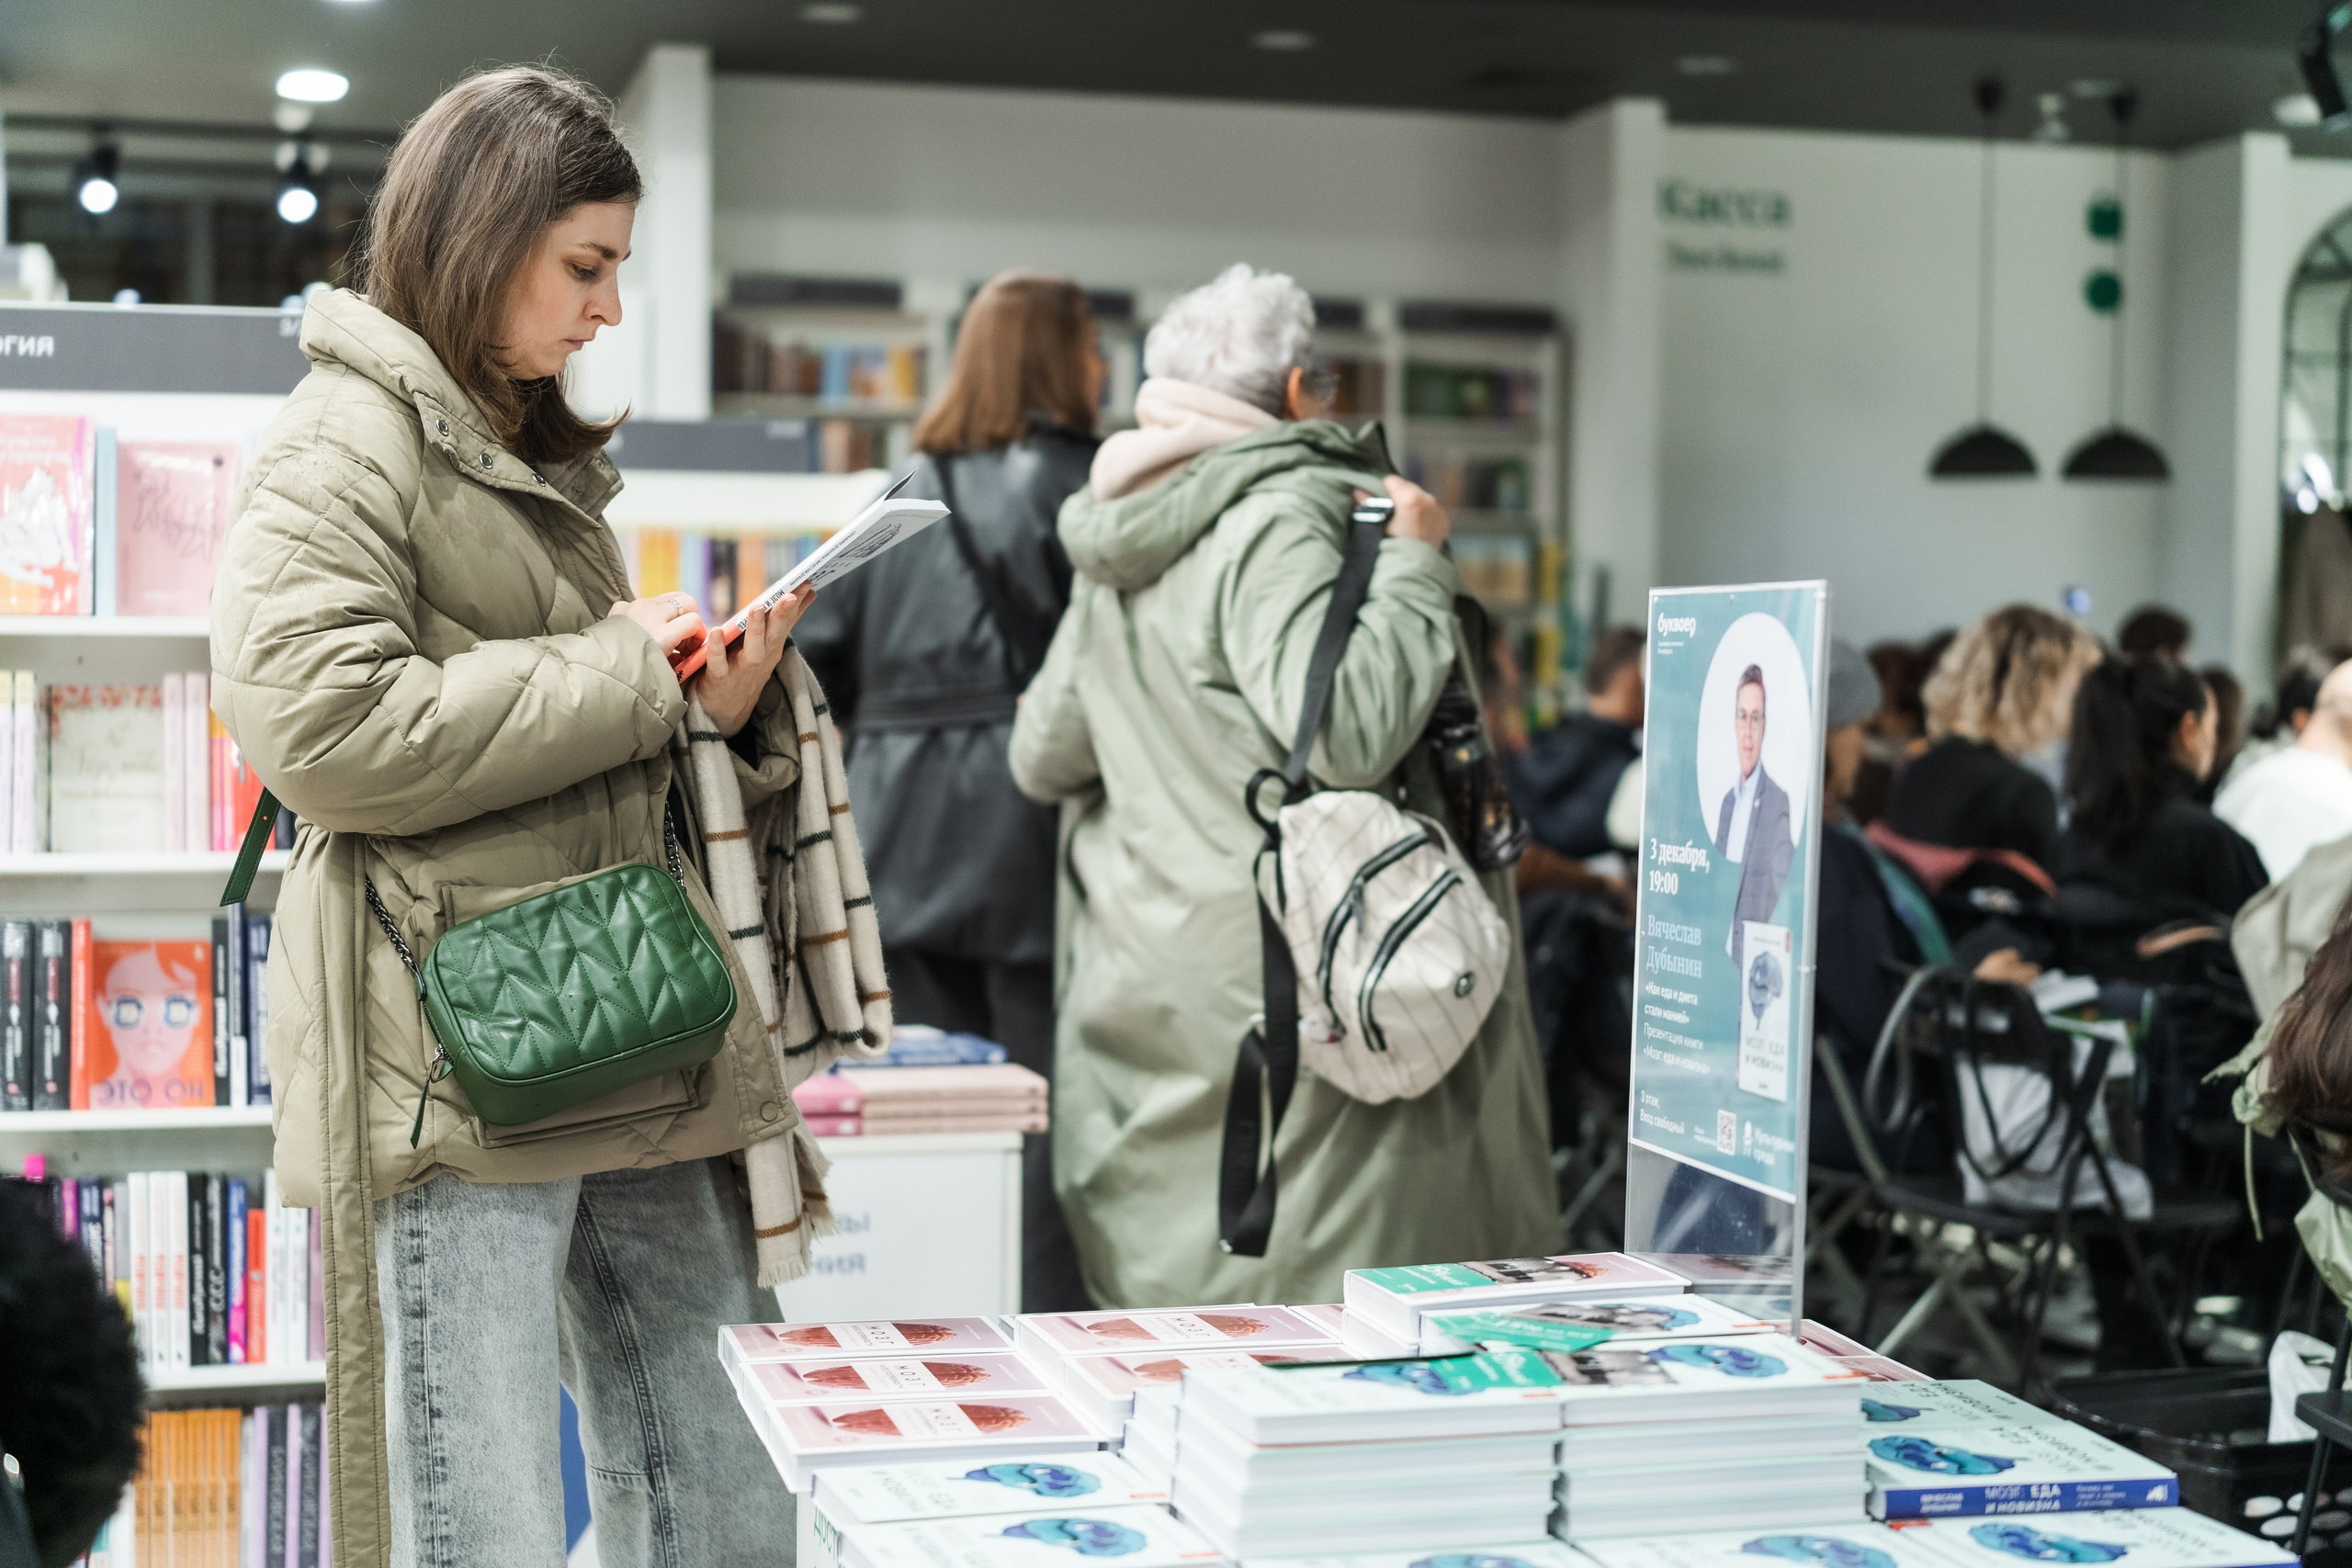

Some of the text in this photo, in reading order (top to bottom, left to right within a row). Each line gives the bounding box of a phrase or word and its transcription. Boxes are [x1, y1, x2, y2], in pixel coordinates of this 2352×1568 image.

[0, 335, 54, 357] ГИЯ
[769, 588, 786, 604] МОЗГ
[1657, 612, 1696, 638] буквоед
[1650, 838, 1710, 874] 3 декабря,
[1649, 869, 1678, 896] 19:00
[1647, 914, 1702, 946] Вячеслав
[1645, 945, 1702, 979] Дубынин
[1661, 987, 1672, 1000] еда
[1673, 990, 1678, 1000] и
[1678, 991, 1698, 1006] диета
[1645, 1004, 1662, 1018] стали
[1644, 1022, 1703, 1051] Презентация книги
[1664, 1052, 1675, 1066] еда
[1675, 1055, 1680, 1066] и
[97, 1077, 205, 1103] ЭТО ОН
[1641, 1089, 1660, 1110] 3 этаж,
[1640, 1108, 1685, 1134] Вход свободный
[865, 1325, 894, 1345] МОЗГ
[1170, 1317, 1211, 1337] МОЗГ
[893, 1365, 926, 1386] МОЗГ
[2030, 1483, 2062, 1498] ЕДА
